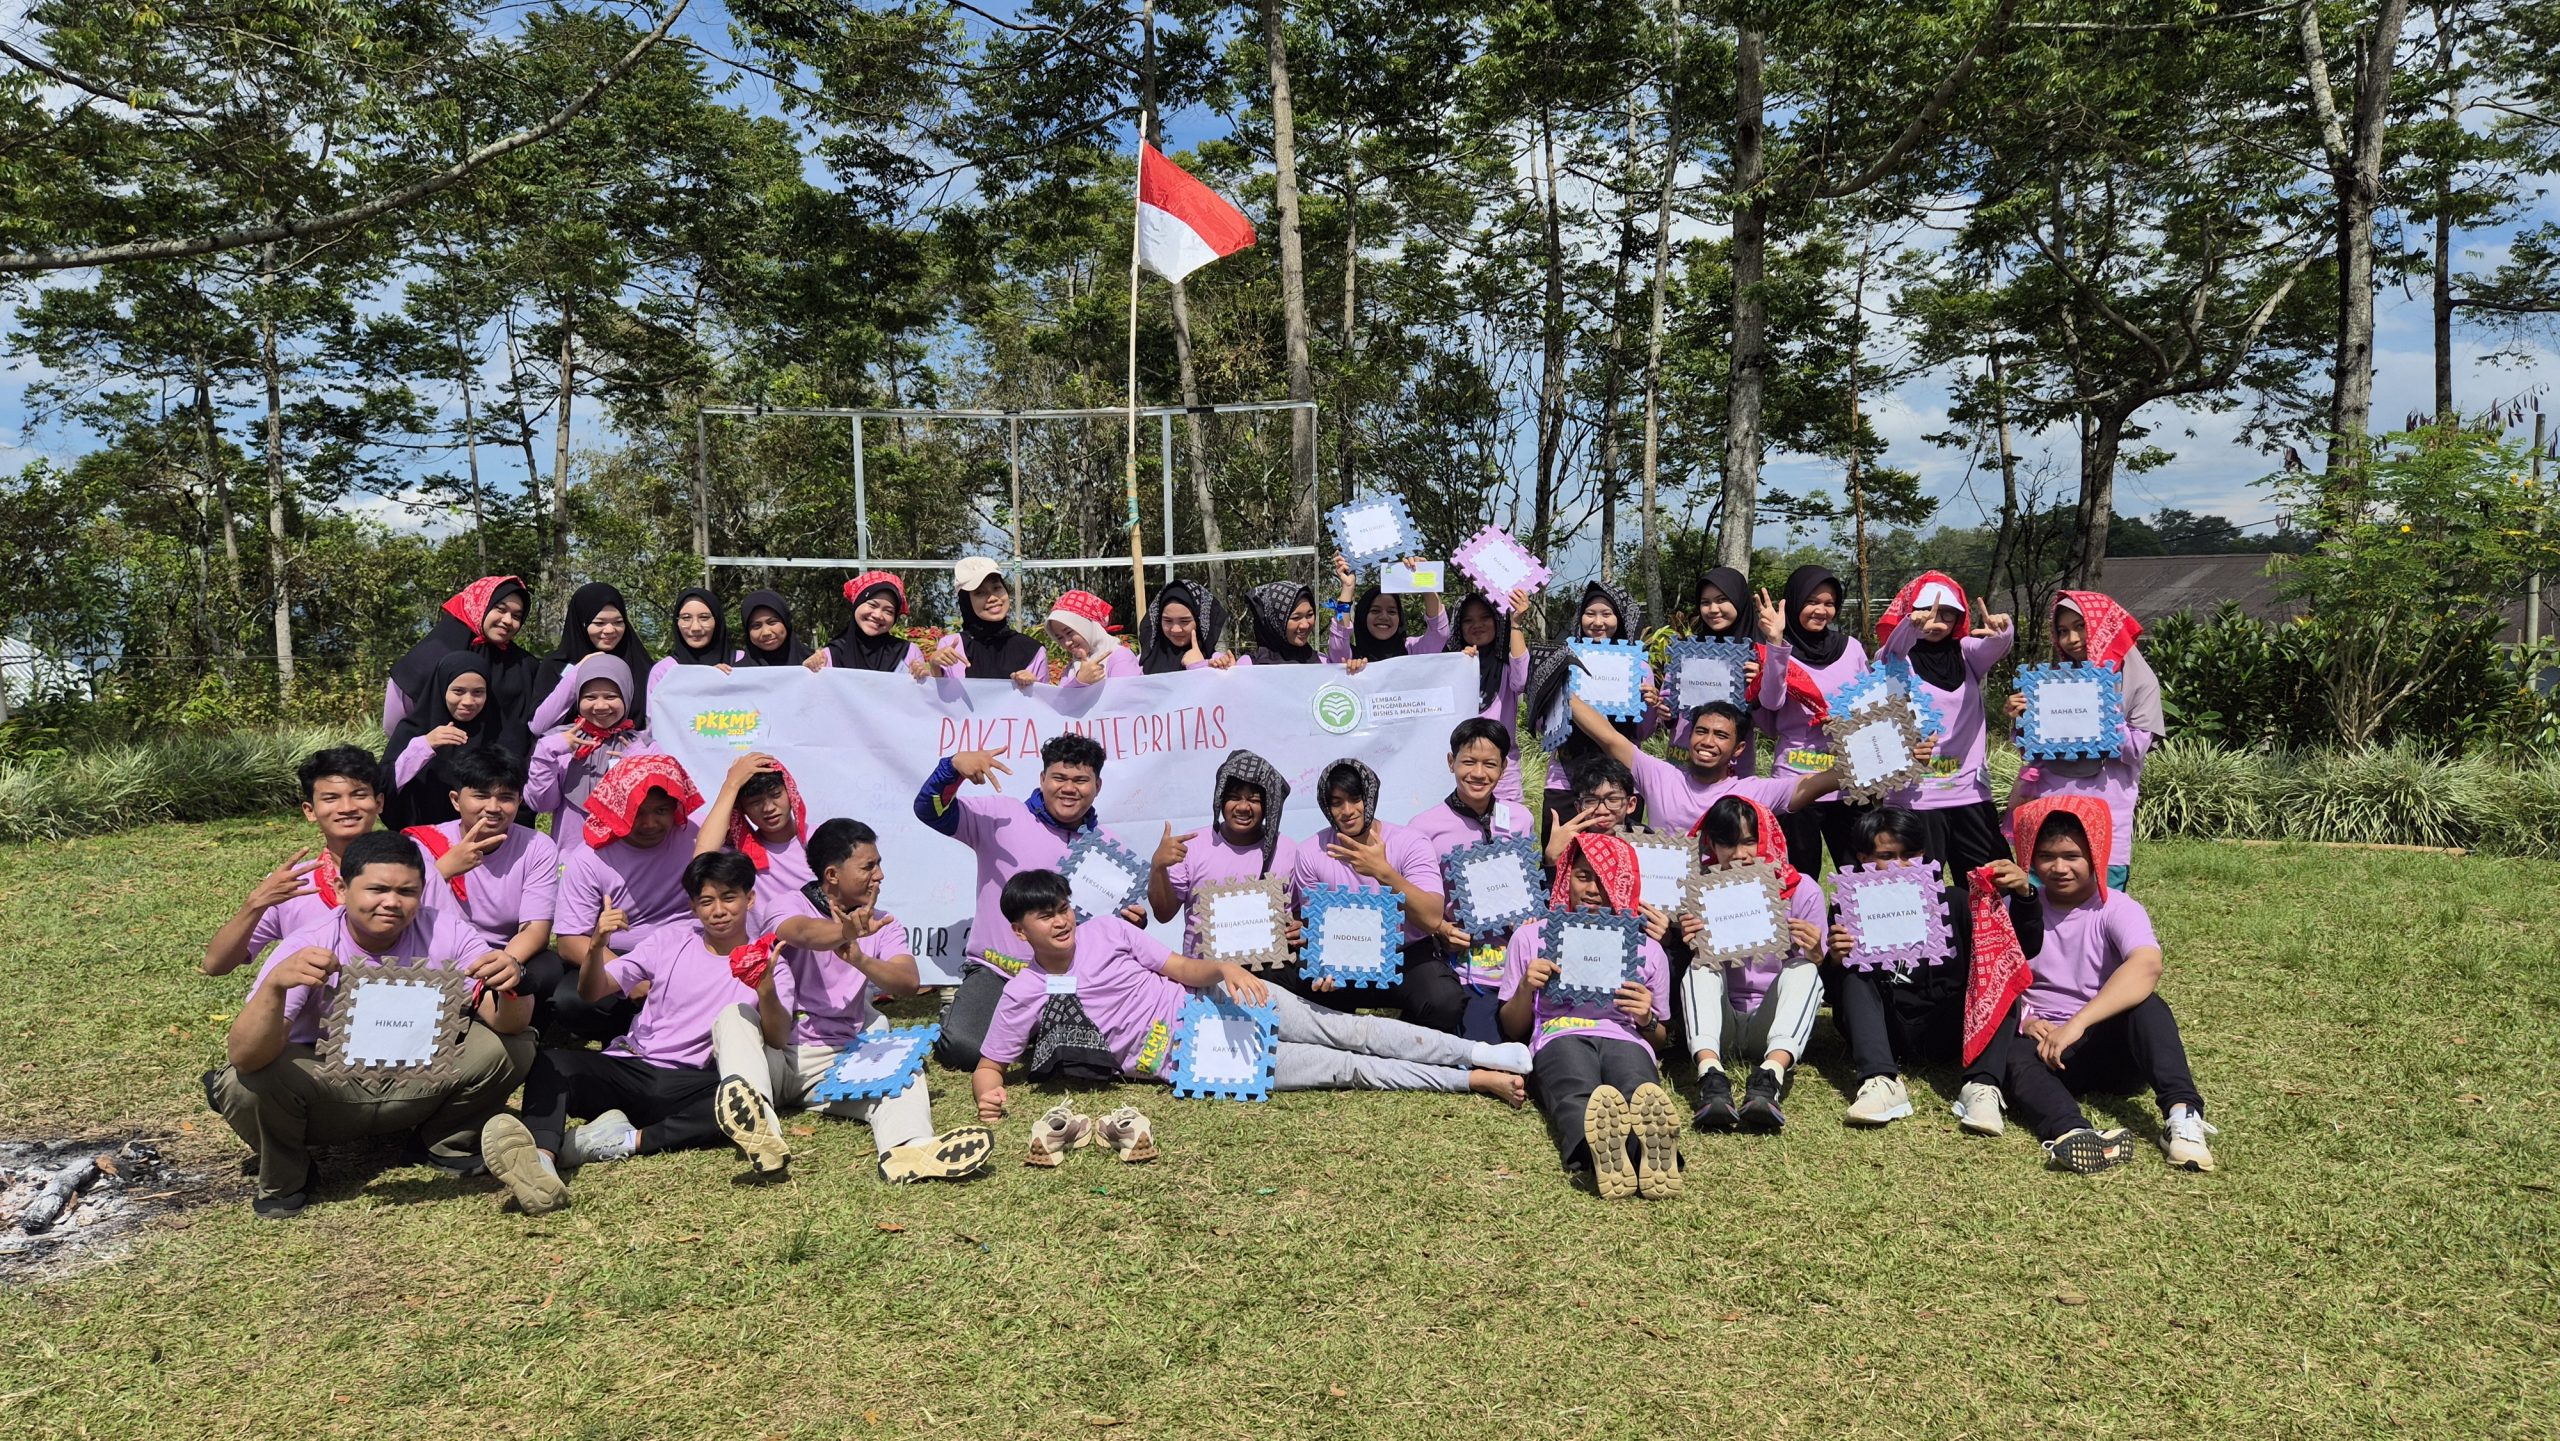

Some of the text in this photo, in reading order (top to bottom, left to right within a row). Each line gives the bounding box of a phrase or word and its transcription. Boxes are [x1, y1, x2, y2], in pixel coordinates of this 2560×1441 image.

[1372, 701, 1426, 710] PENGEMBANGAN
[695, 711, 757, 731] PKKMB
[939, 705, 1228, 760] PAKTA TEGRITAS
[1082, 875, 1117, 899] PERSATUAN
[1486, 883, 1509, 892] SOSIAL
[1715, 909, 1761, 922] PERWAKILAN
[1867, 910, 1917, 921] KERAKYATAN
[1216, 918, 1269, 929] KEBIJAKSANAAN
[1333, 934, 1372, 942] INDONESIA
[375, 1019, 414, 1028] HIKMAT
[1137, 1023, 1167, 1073] PKKMB
